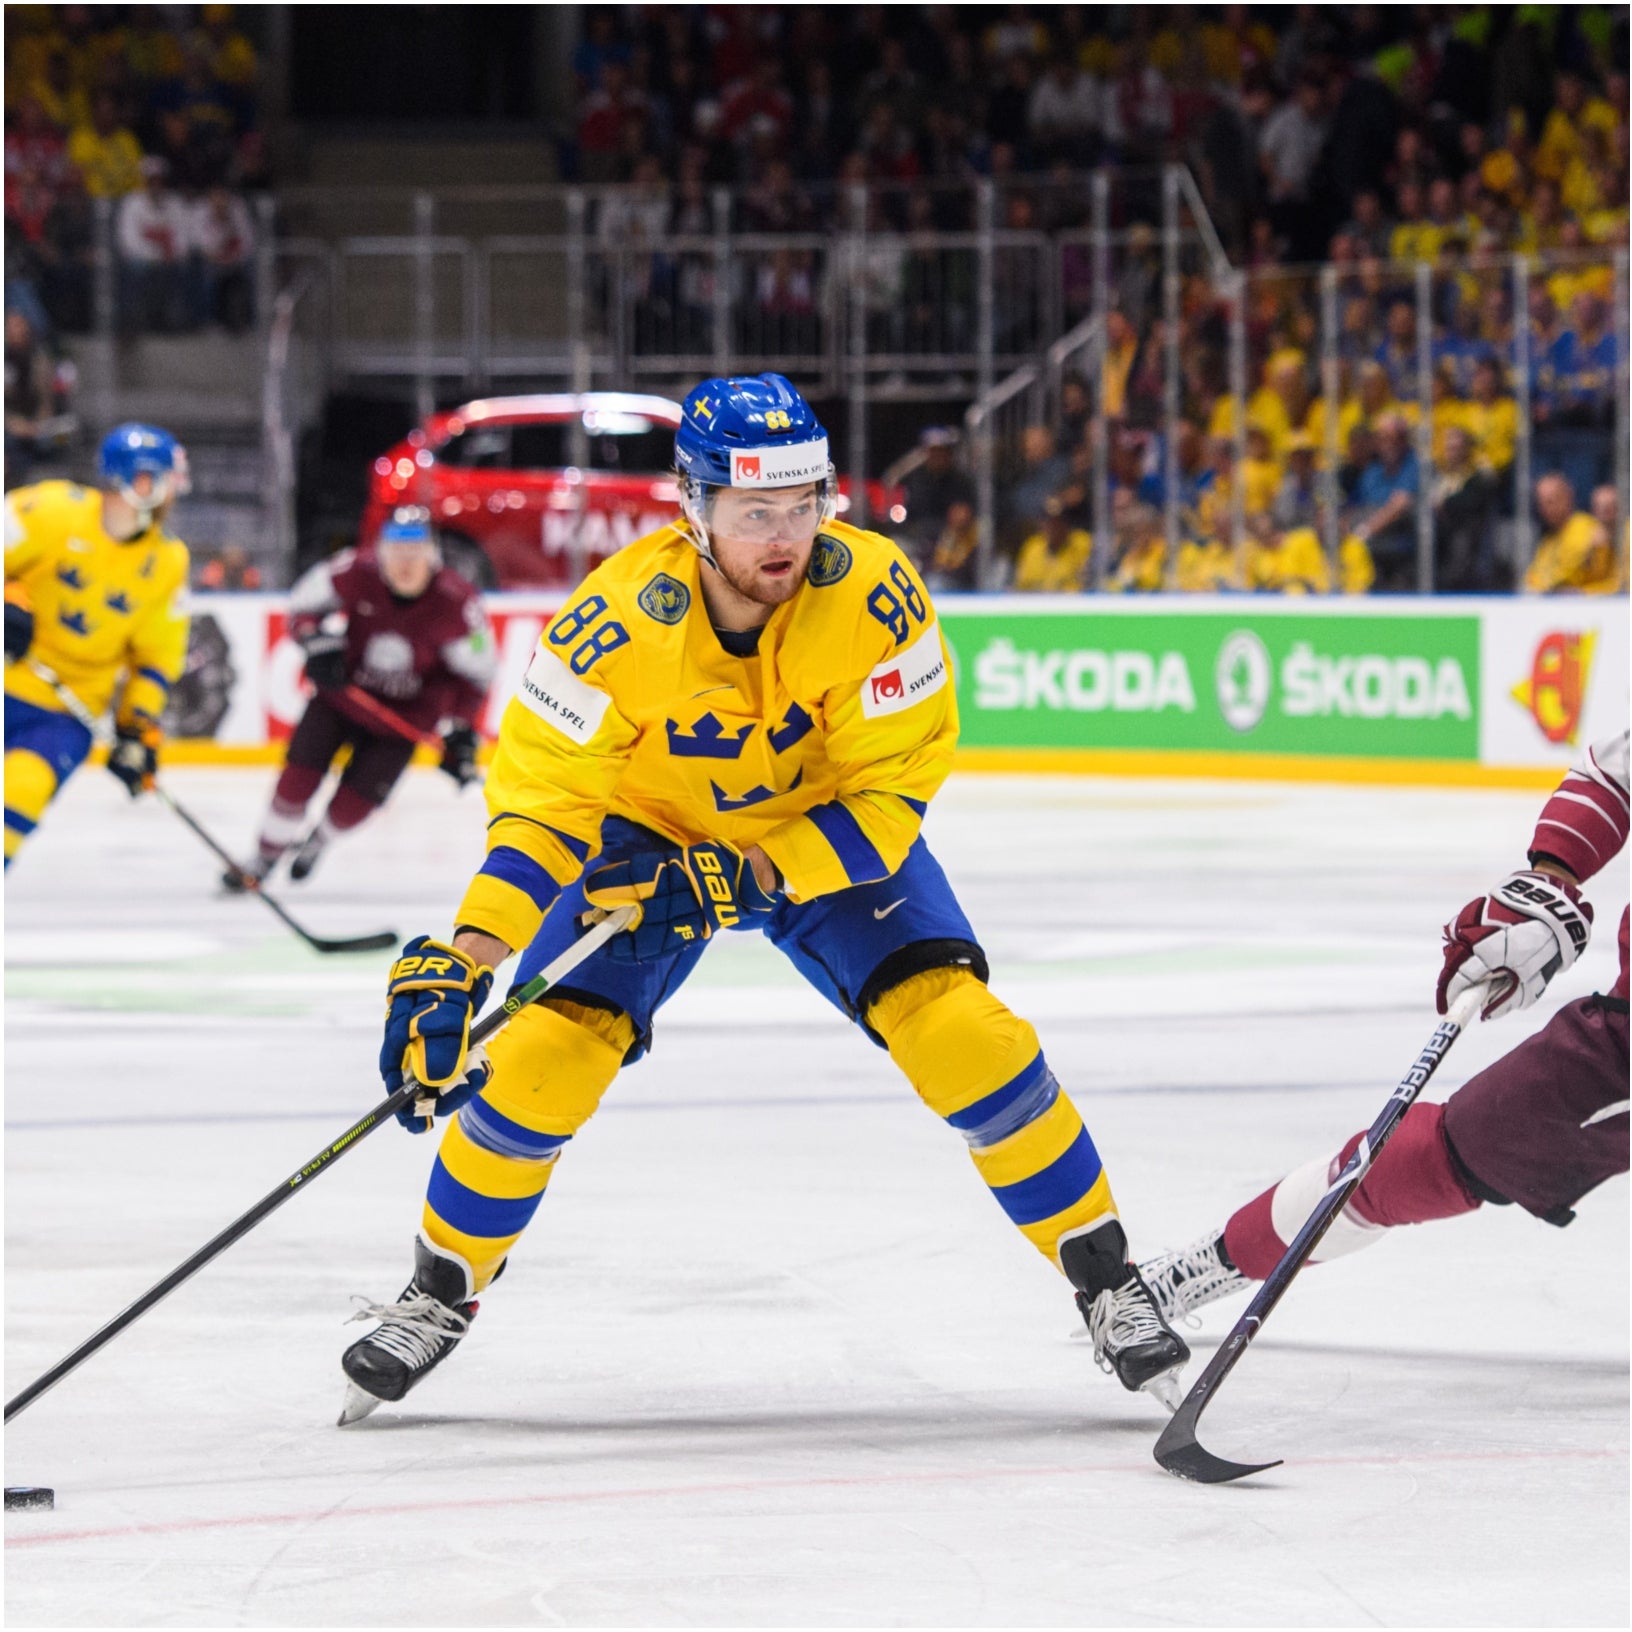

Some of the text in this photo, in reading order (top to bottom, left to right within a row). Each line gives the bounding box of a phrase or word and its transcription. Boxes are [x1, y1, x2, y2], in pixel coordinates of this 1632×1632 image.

[765, 410, 791, 430] 88
[767, 468, 809, 481] SVENSKA
[867, 560, 926, 646] 88
[549, 595, 631, 675] 88
[910, 661, 944, 693] SVENSKA
[974, 637, 1472, 721] ŠKODA ŠKODA
[560, 708, 586, 730] SPEL
[1390, 1021, 1461, 1101] BAUER
